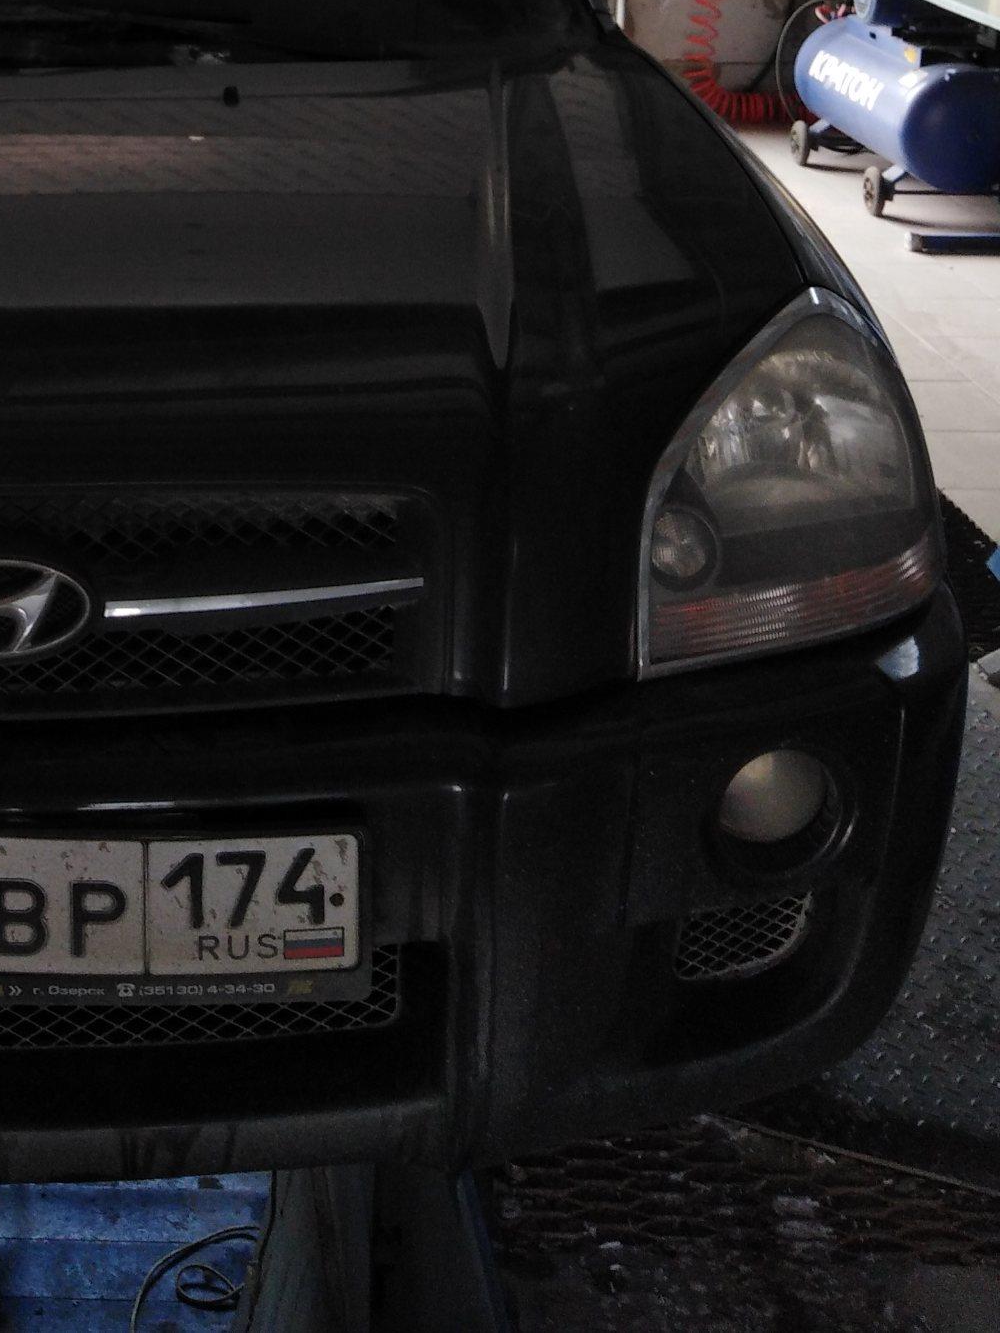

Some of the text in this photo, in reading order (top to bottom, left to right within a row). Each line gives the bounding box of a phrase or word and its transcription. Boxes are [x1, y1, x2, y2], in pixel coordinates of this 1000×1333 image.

[808, 49, 885, 111] КРАТОН
[159, 847, 325, 930] 174
[198, 933, 278, 961] RUS
[206, 982, 276, 995] 4-34-30
